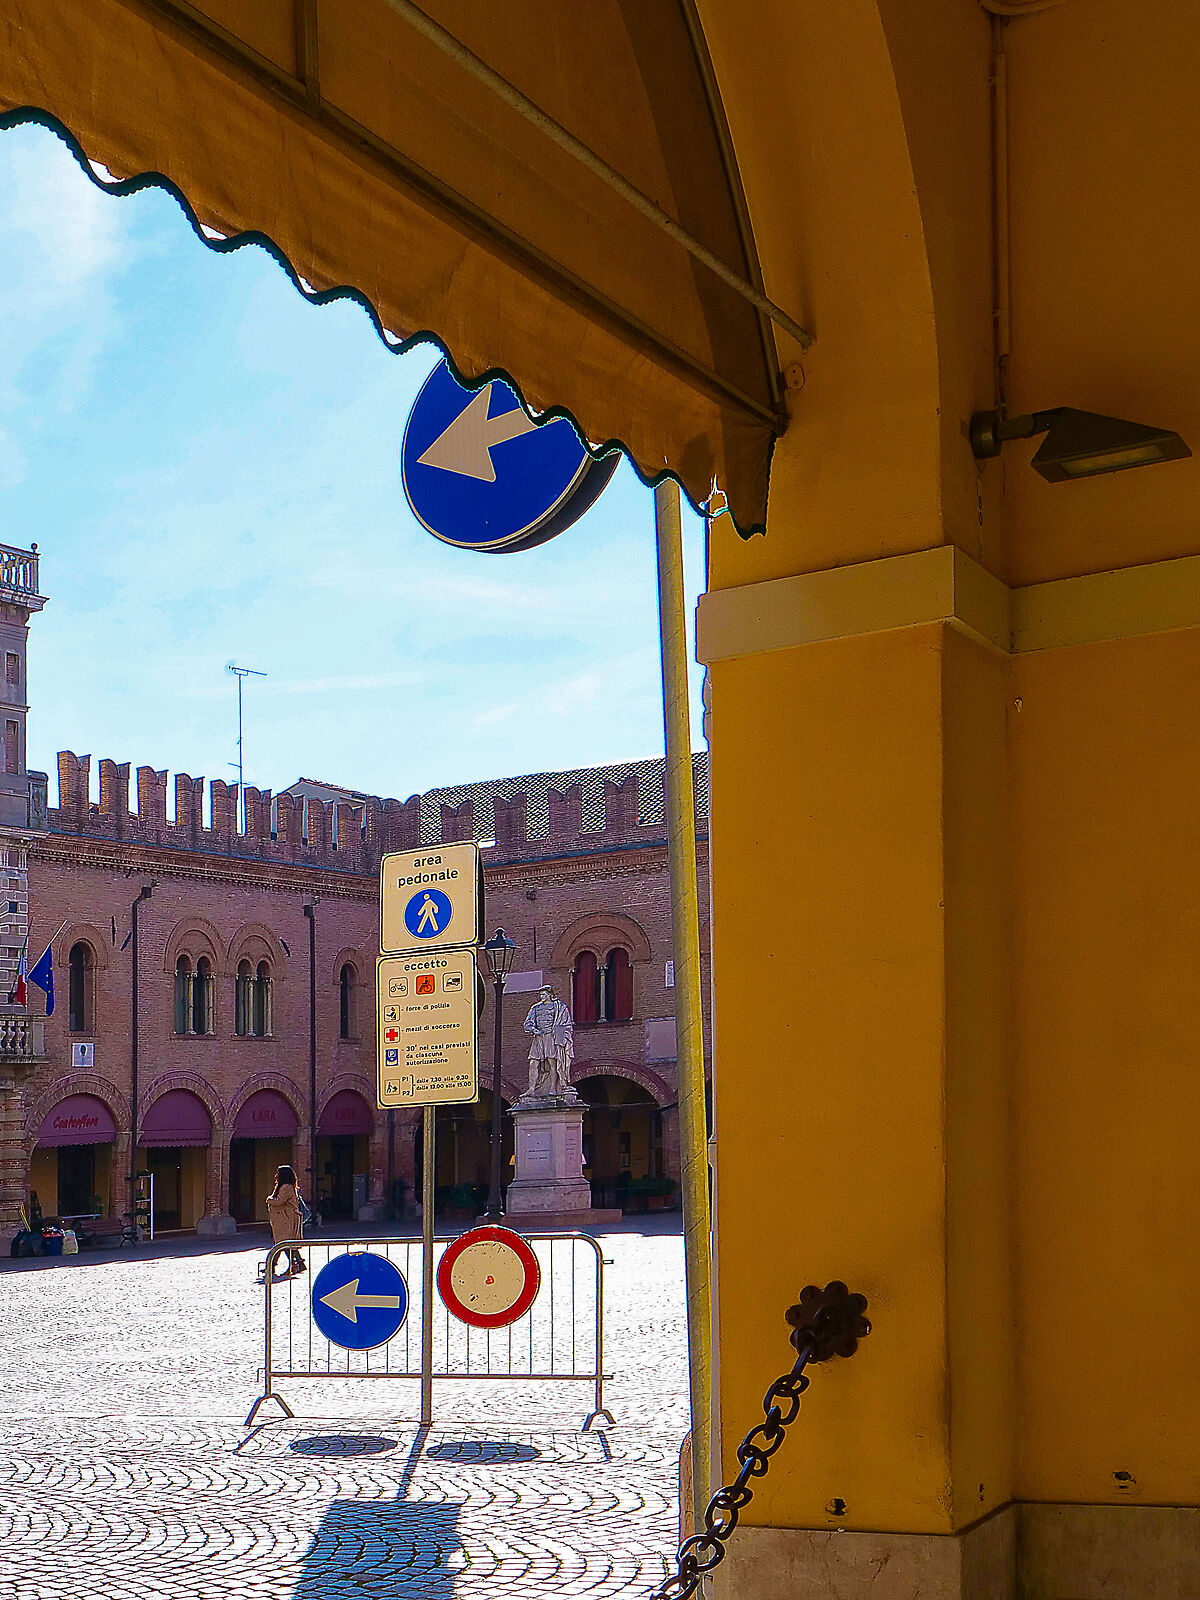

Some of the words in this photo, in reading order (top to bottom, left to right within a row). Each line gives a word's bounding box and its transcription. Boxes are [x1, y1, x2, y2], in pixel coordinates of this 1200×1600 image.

[413, 855, 442, 868] area
[398, 868, 459, 888] pedonale
[404, 959, 448, 971] eccetto
[430, 1002, 450, 1011] polizia
[445, 1041, 471, 1049] previsti
[405, 1057, 449, 1066] autorizzazione
[252, 1109, 277, 1122] LARA
